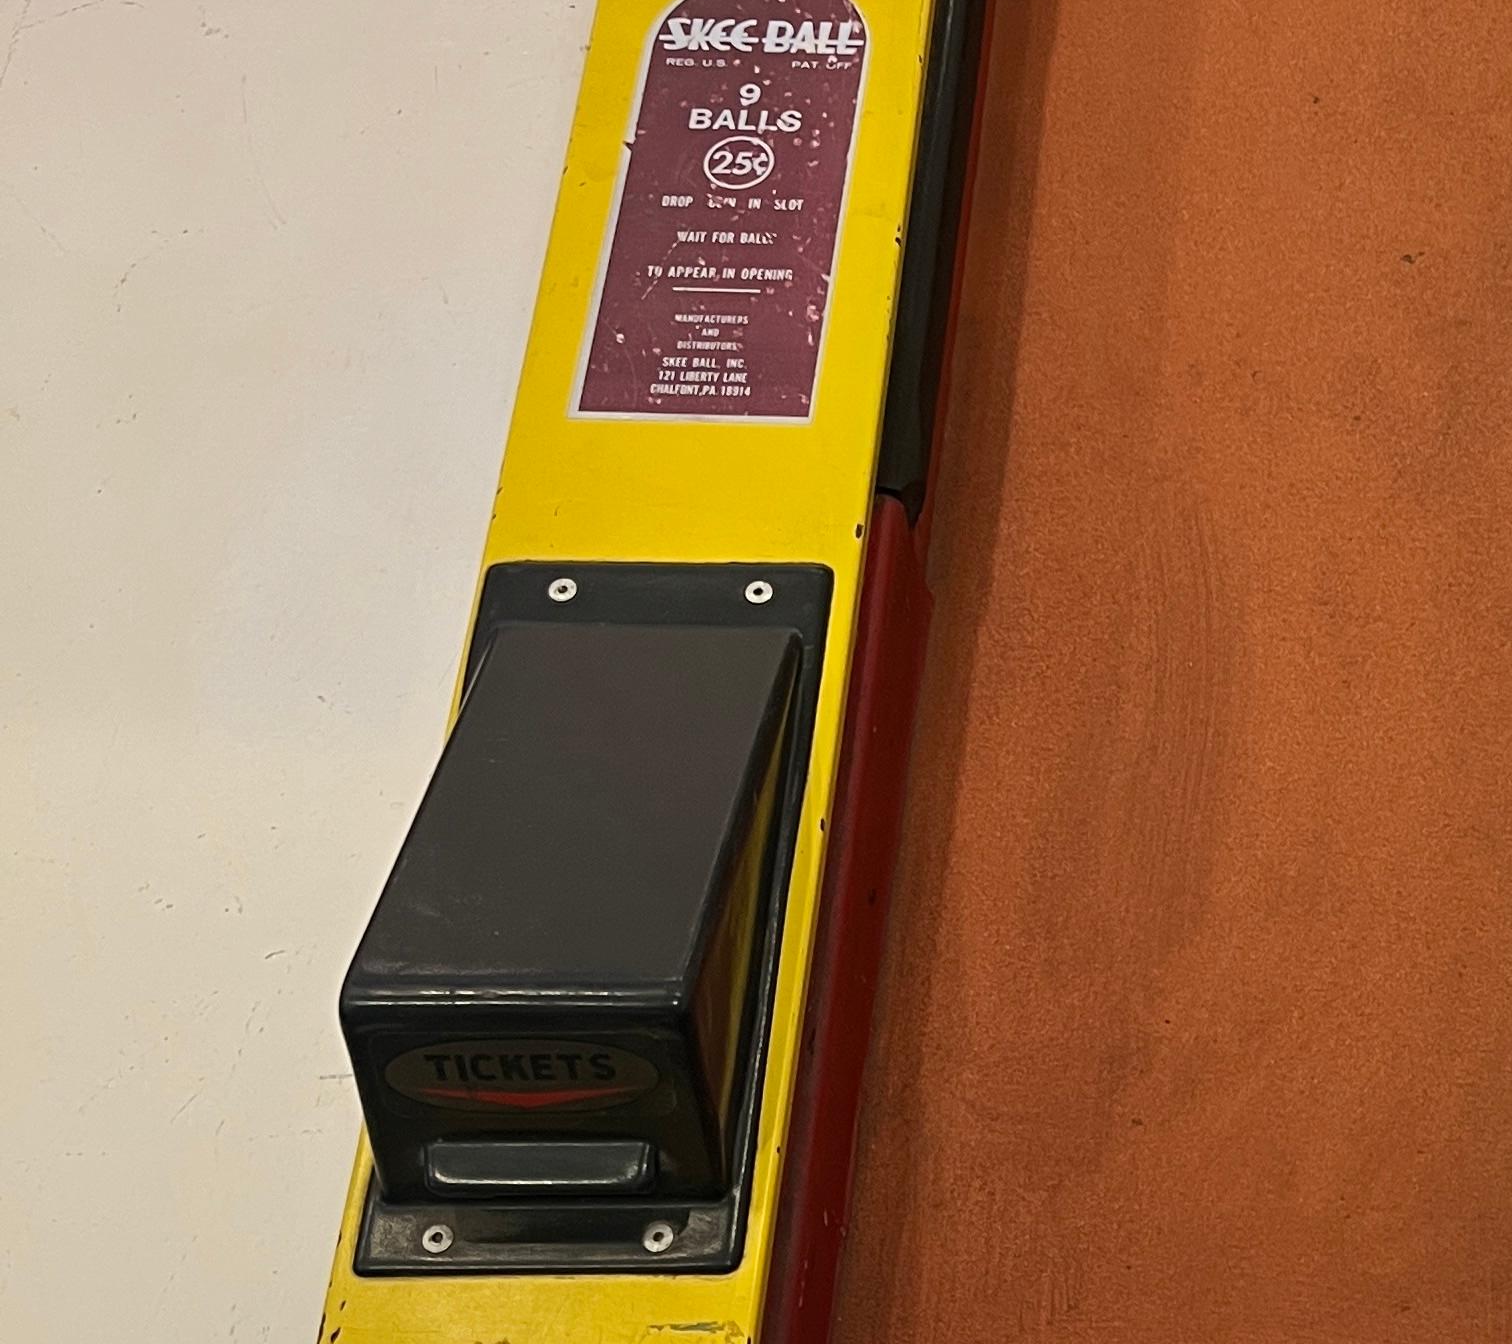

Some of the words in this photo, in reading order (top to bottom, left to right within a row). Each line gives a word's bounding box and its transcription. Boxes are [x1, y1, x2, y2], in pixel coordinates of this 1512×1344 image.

[659, 17, 759, 52] SKEE
[762, 19, 864, 55] BALL
[739, 83, 761, 106] 9
[688, 107, 802, 133] BALLS
[711, 150, 769, 176] 25¢
[661, 195, 694, 207] DROP
[748, 198, 762, 210] IN
[773, 199, 804, 211] SLOT
[677, 231, 706, 243] WAIT
[712, 231, 735, 244] FOR
[648, 265, 663, 278] TO
[668, 266, 717, 279] APPEAR
[722, 268, 735, 279] IN
[741, 268, 793, 281] OPENING
[674, 313, 749, 324] MANUFACTURERS
[701, 327, 720, 337] AND
[676, 340, 739, 351] DISTRIBUTORS
[662, 357, 688, 368] SKEE
[658, 370, 676, 381] 121
[680, 371, 720, 382] LIBERTY
[722, 372, 748, 383] LANE
[721, 385, 751, 397] 18914
[424, 1054, 617, 1082] TICKETS
